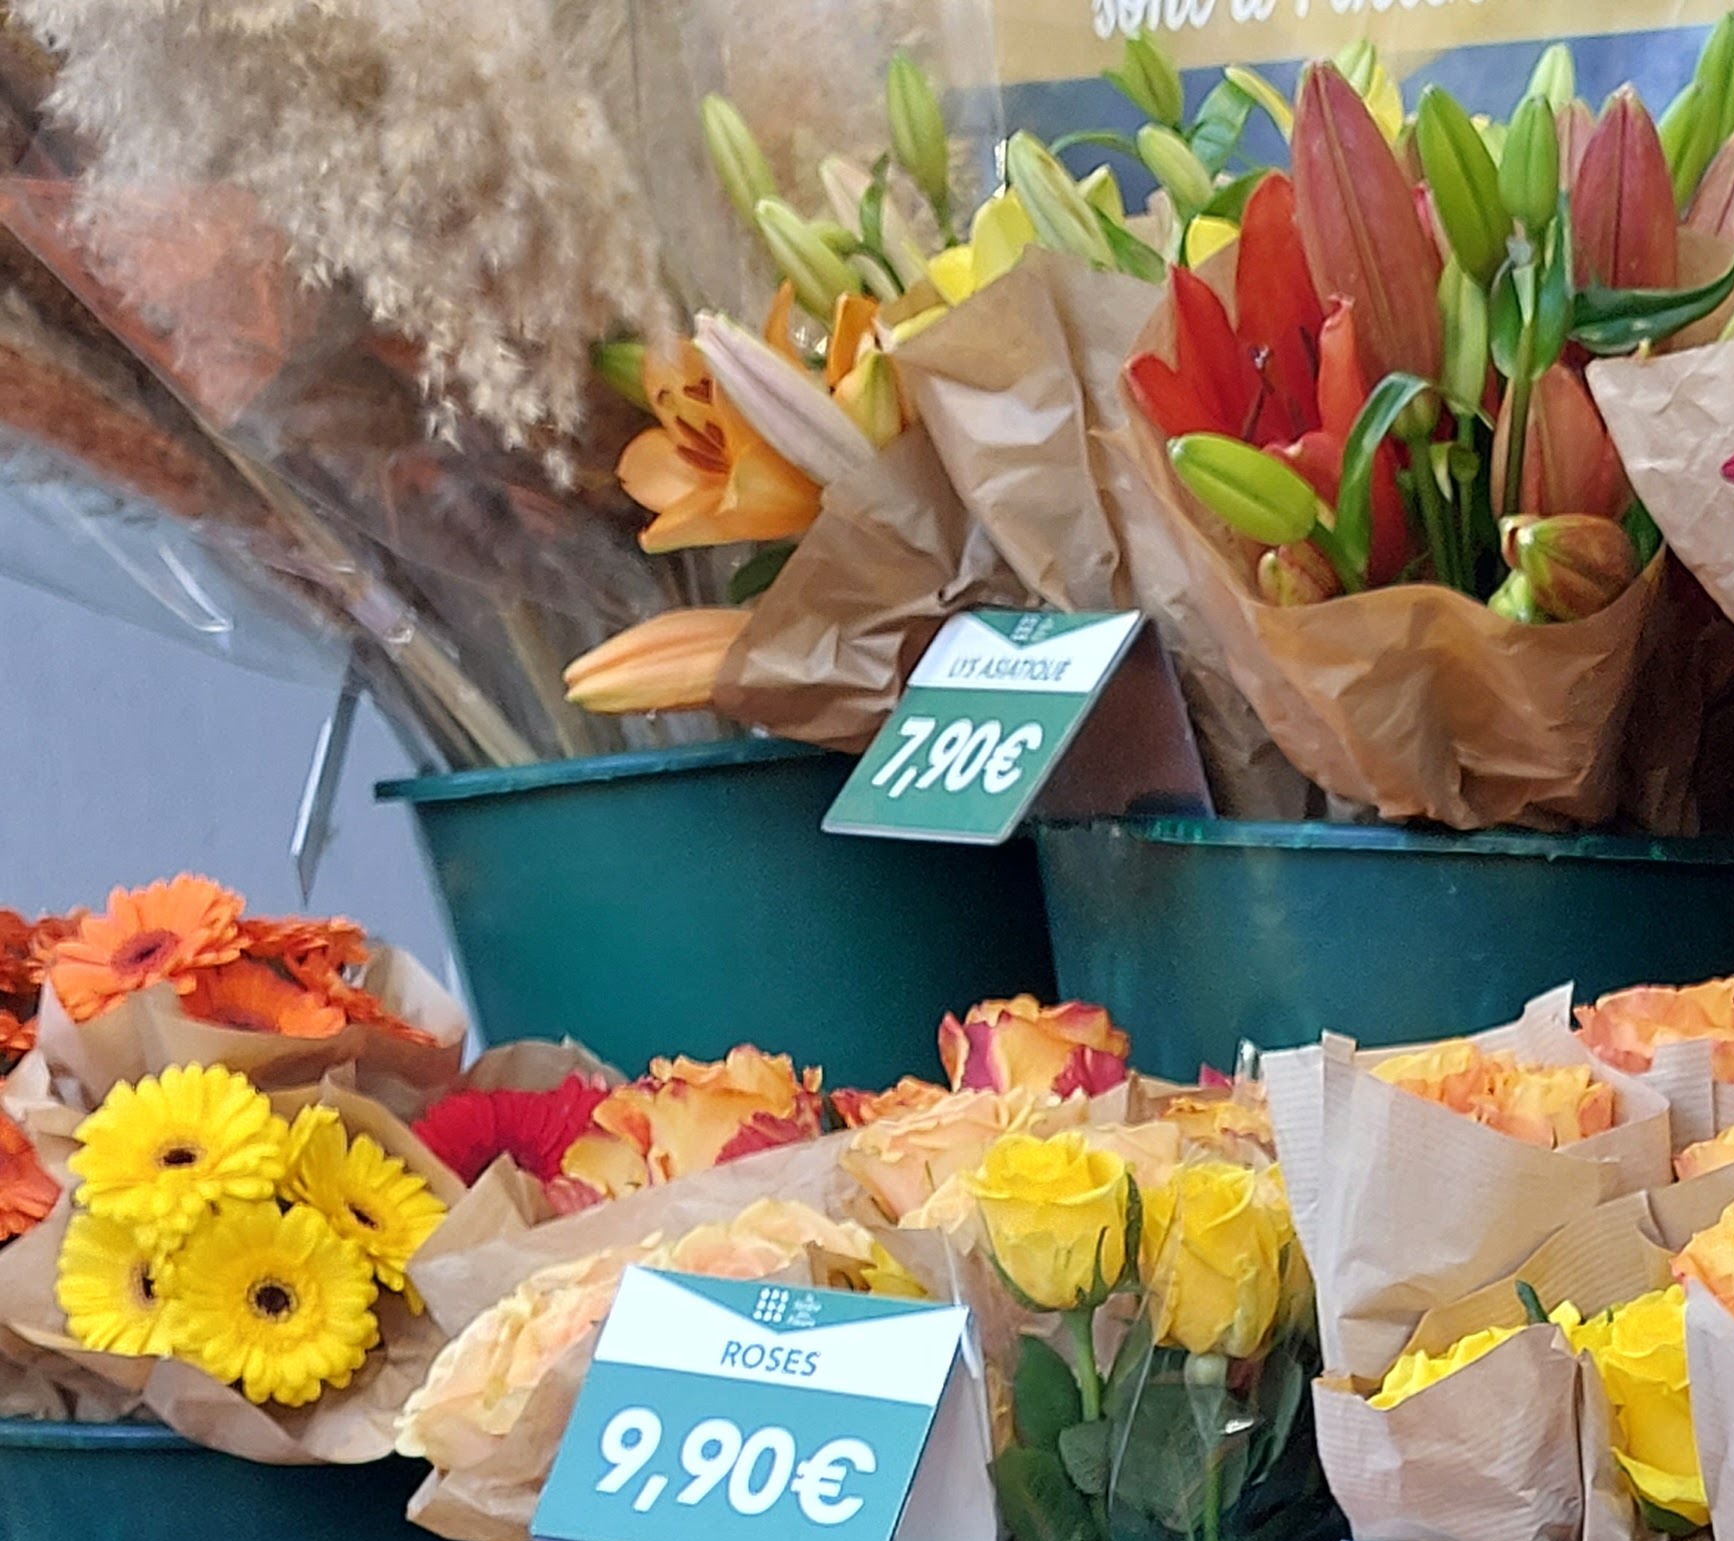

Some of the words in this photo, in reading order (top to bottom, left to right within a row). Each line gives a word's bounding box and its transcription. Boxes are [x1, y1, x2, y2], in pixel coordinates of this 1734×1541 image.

[948, 656, 982, 680] LYS
[976, 656, 1073, 683] ASIATIQUE
[872, 716, 1043, 798] 7,90€
[720, 1340, 821, 1377] ROSES
[595, 1406, 877, 1525] 9,90€
